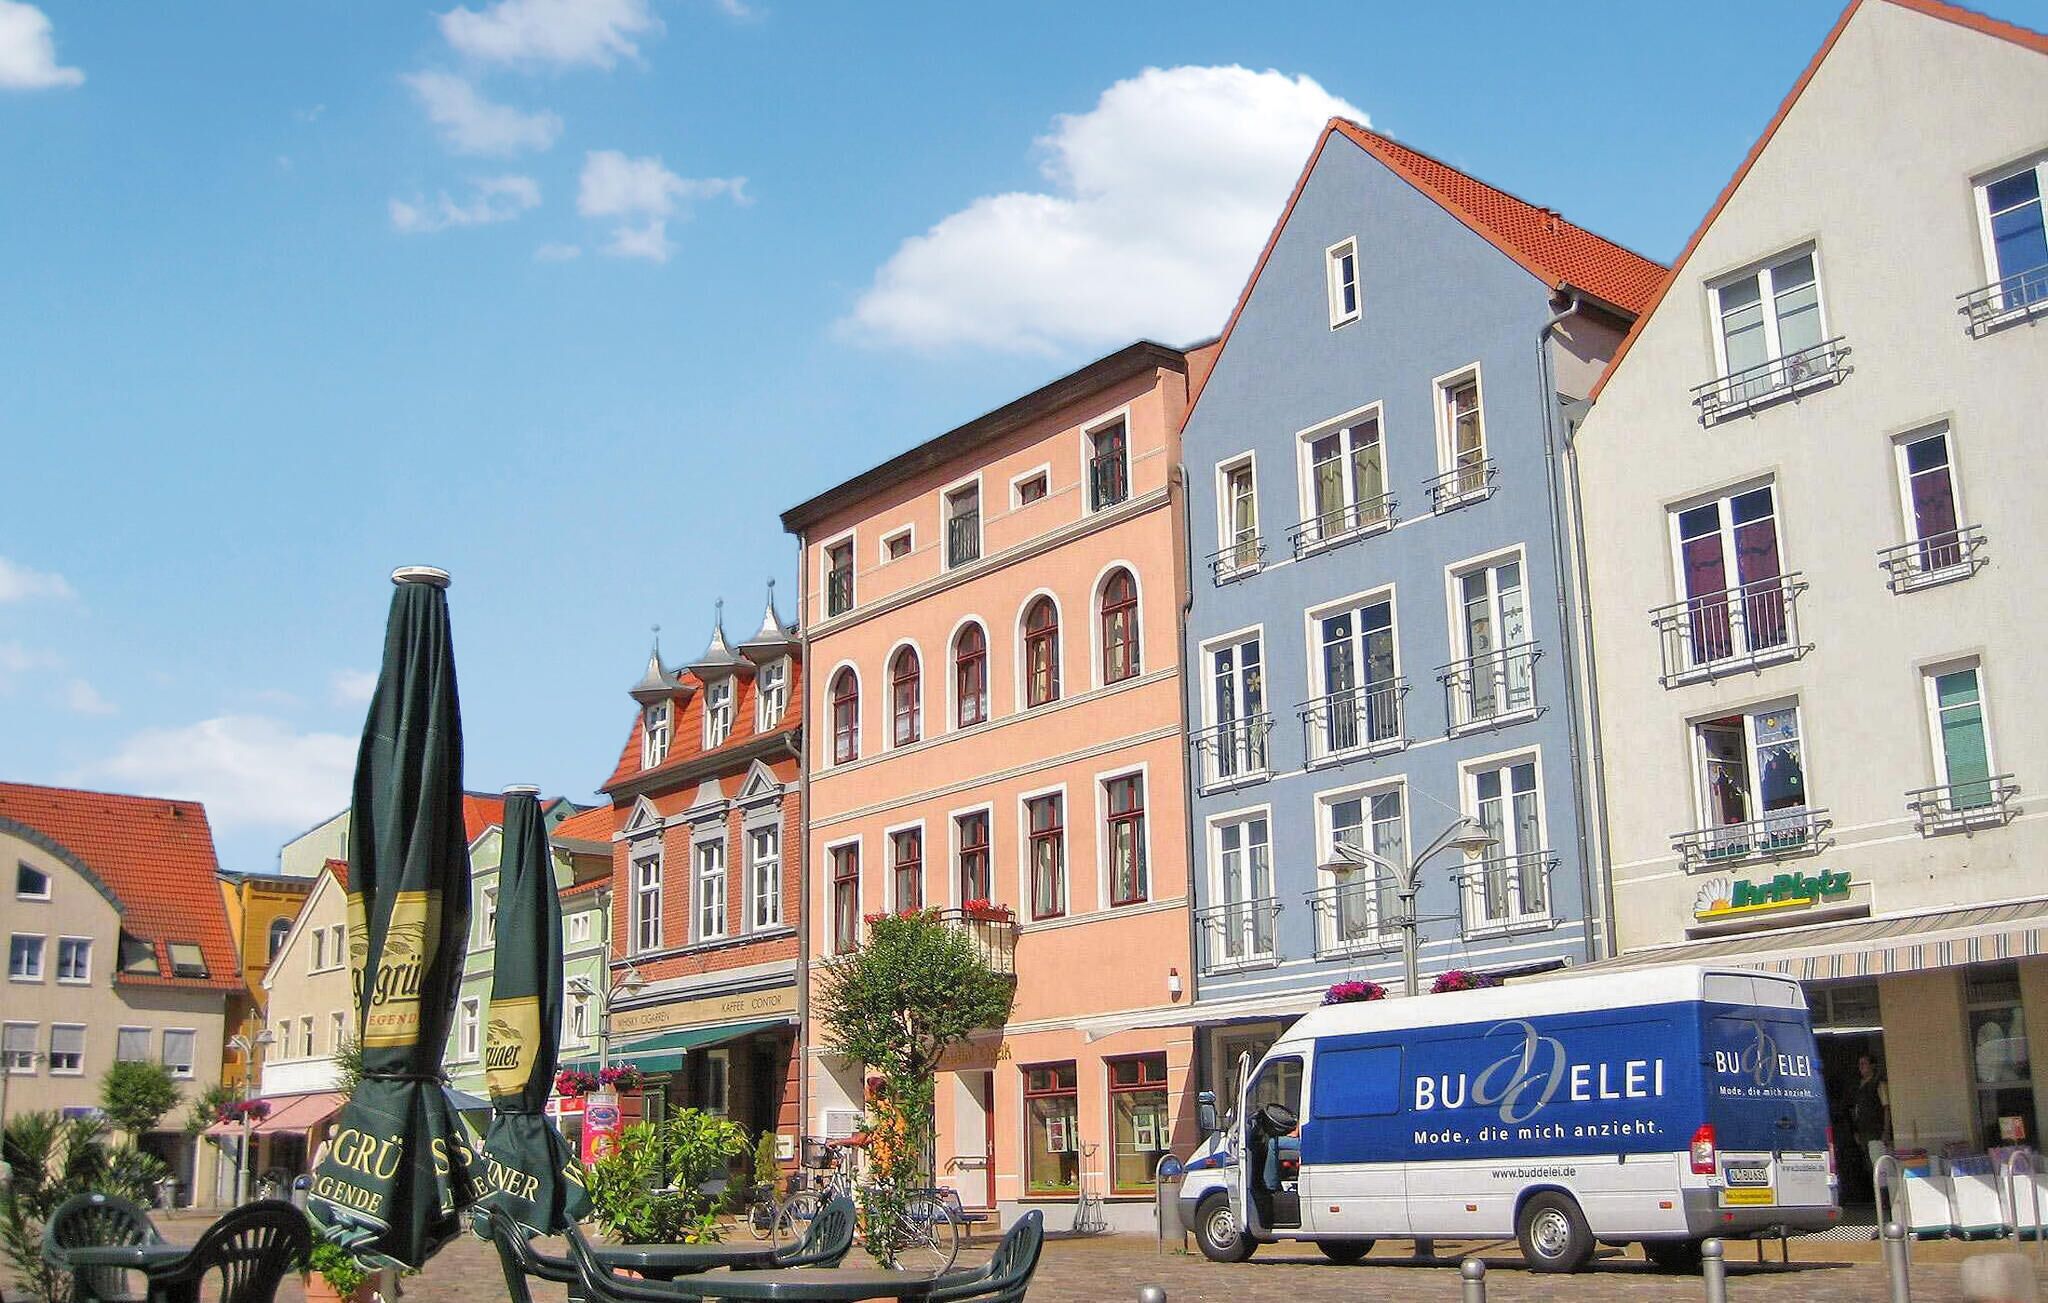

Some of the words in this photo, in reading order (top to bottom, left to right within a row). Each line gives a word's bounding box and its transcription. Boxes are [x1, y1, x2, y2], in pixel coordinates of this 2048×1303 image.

[721, 1000, 745, 1013] KAFFEE
[752, 995, 782, 1010] CONTOR
[1748, 1087, 1761, 1097] die
[1414, 1130, 1470, 1145] Mode,
[1479, 1127, 1509, 1142] die
[1518, 1124, 1565, 1140] mich
[1574, 1119, 1664, 1137] anzieht.
[1491, 1166, 1577, 1180] www.buddelei.de
[318, 1176, 384, 1213] GENDE
